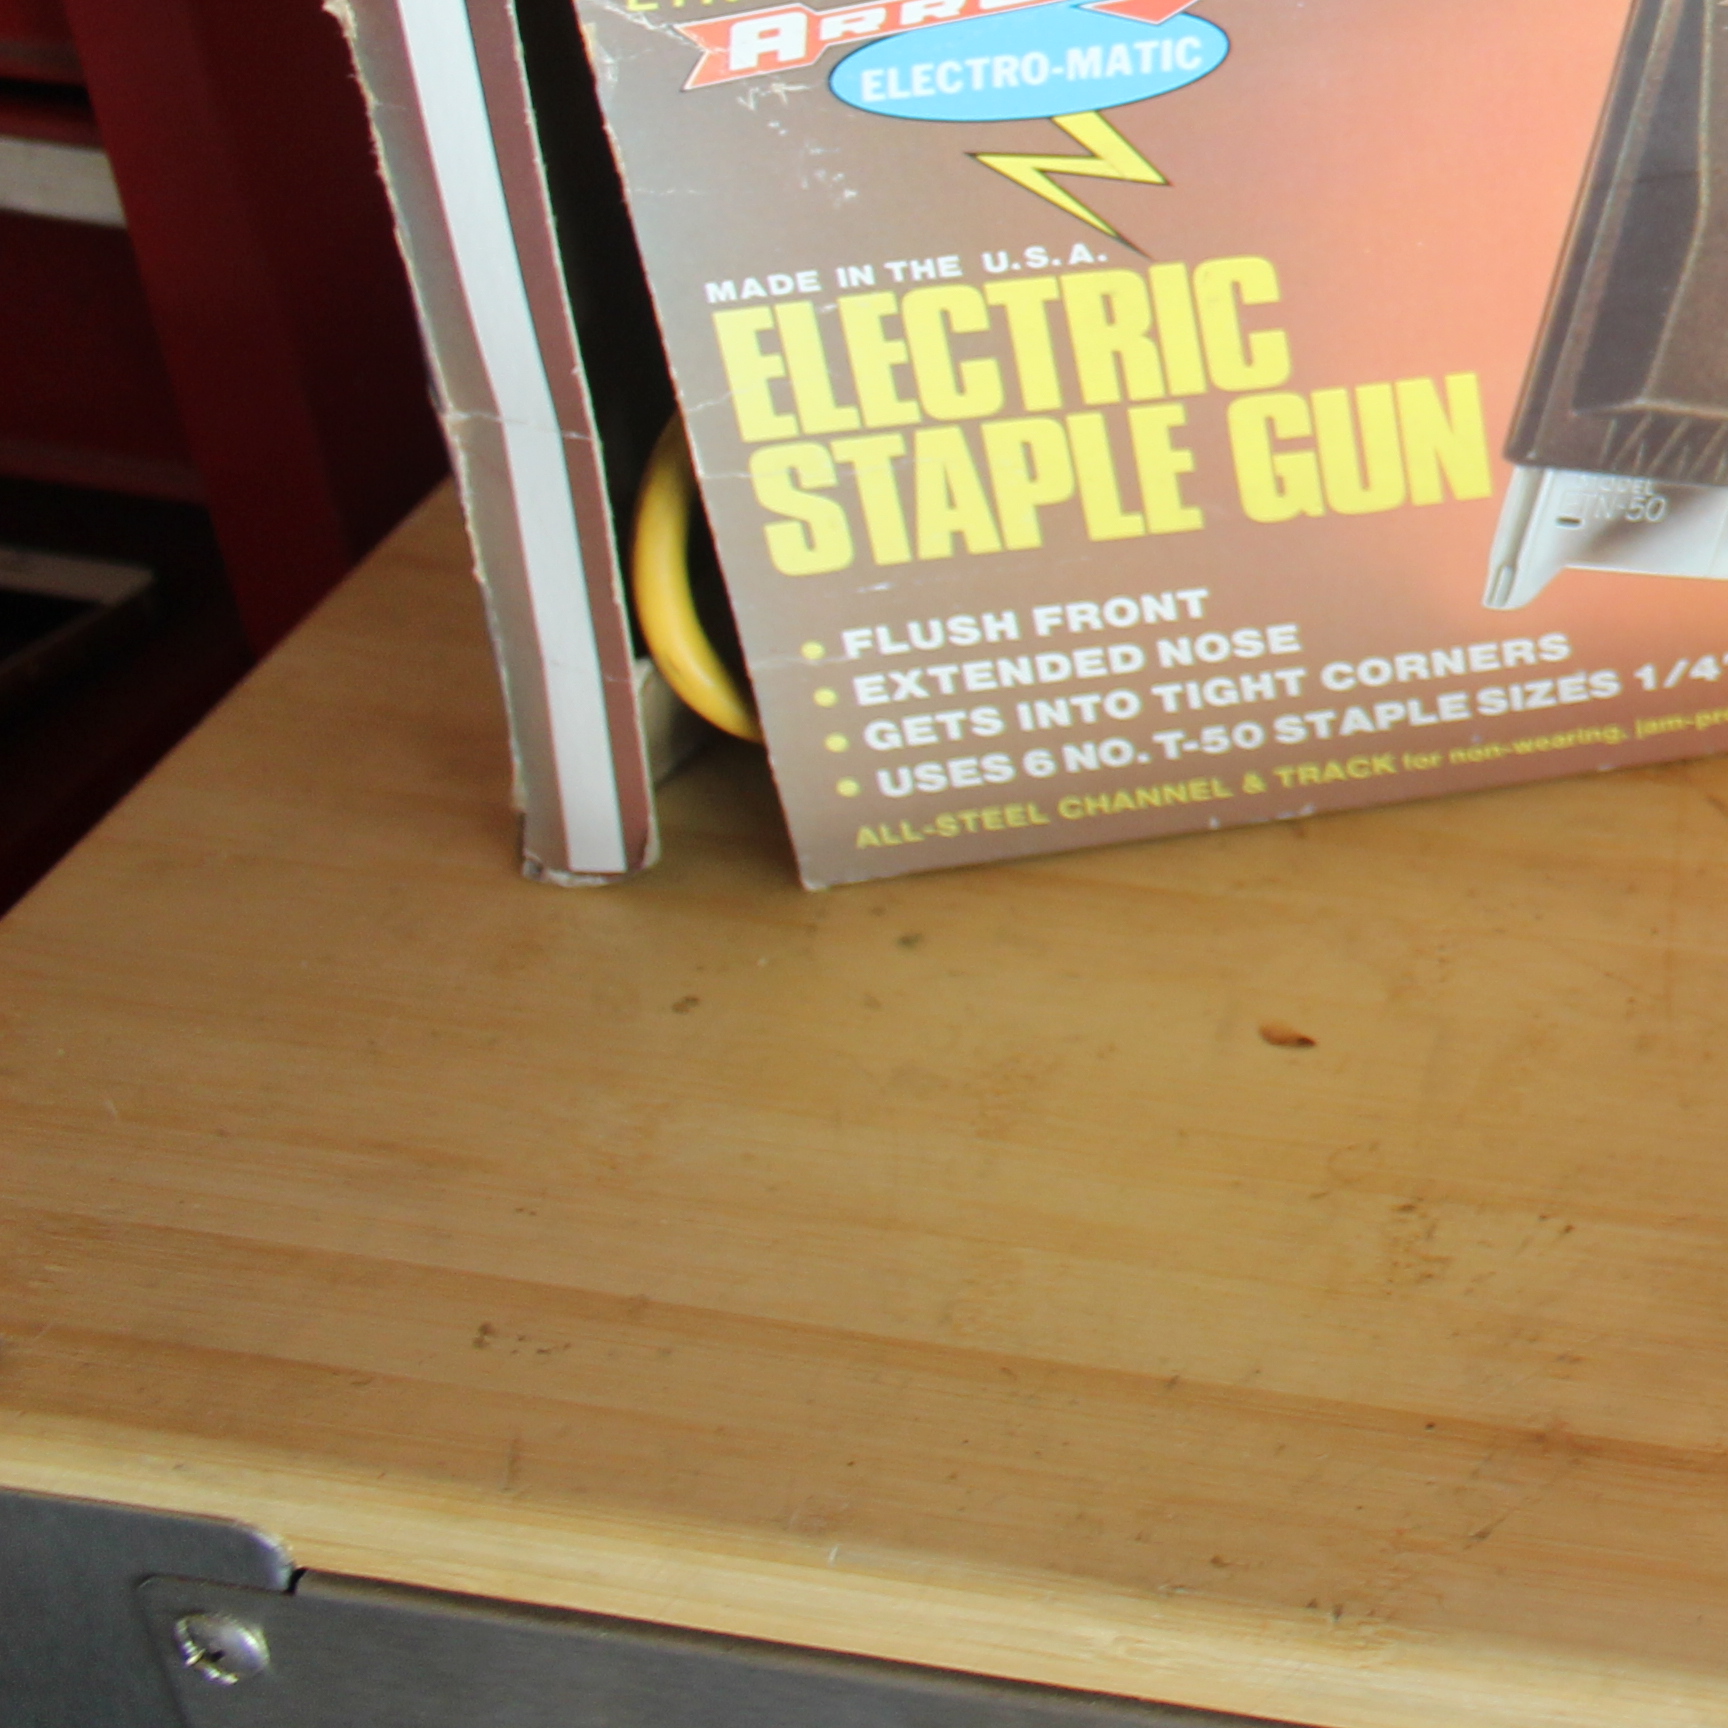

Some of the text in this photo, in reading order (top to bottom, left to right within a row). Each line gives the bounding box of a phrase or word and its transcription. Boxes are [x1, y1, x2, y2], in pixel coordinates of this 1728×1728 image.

[860, 35, 1204, 104] ELECTRO-MATIC
[704, 241, 1110, 306] MADE IN THE U.S.A.
[711, 255, 1293, 445] ELECTRIC
[748, 371, 1495, 577] STAPLE GUN
[841, 587, 1211, 661] FLUSH FRONT
[852, 622, 1303, 708] EXTENDED NOSE
[863, 632, 1571, 752] GETS INTO TIGHT CORNERS
[875, 751, 1016, 799] USES
[1021, 746, 1057, 779] 6
[1061, 737, 1151, 775] NO.
[1151, 721, 1265, 761] T-50
[1273, 691, 1471, 746] STAPLE
[1476, 667, 1622, 718] SIZES
[854, 801, 1051, 851] ALL-STEEL
[1057, 777, 1234, 822] CHANNEL
[1240, 771, 1268, 796] &
[1273, 750, 1399, 791] TRACK
[1402, 747, 1443, 771] for
